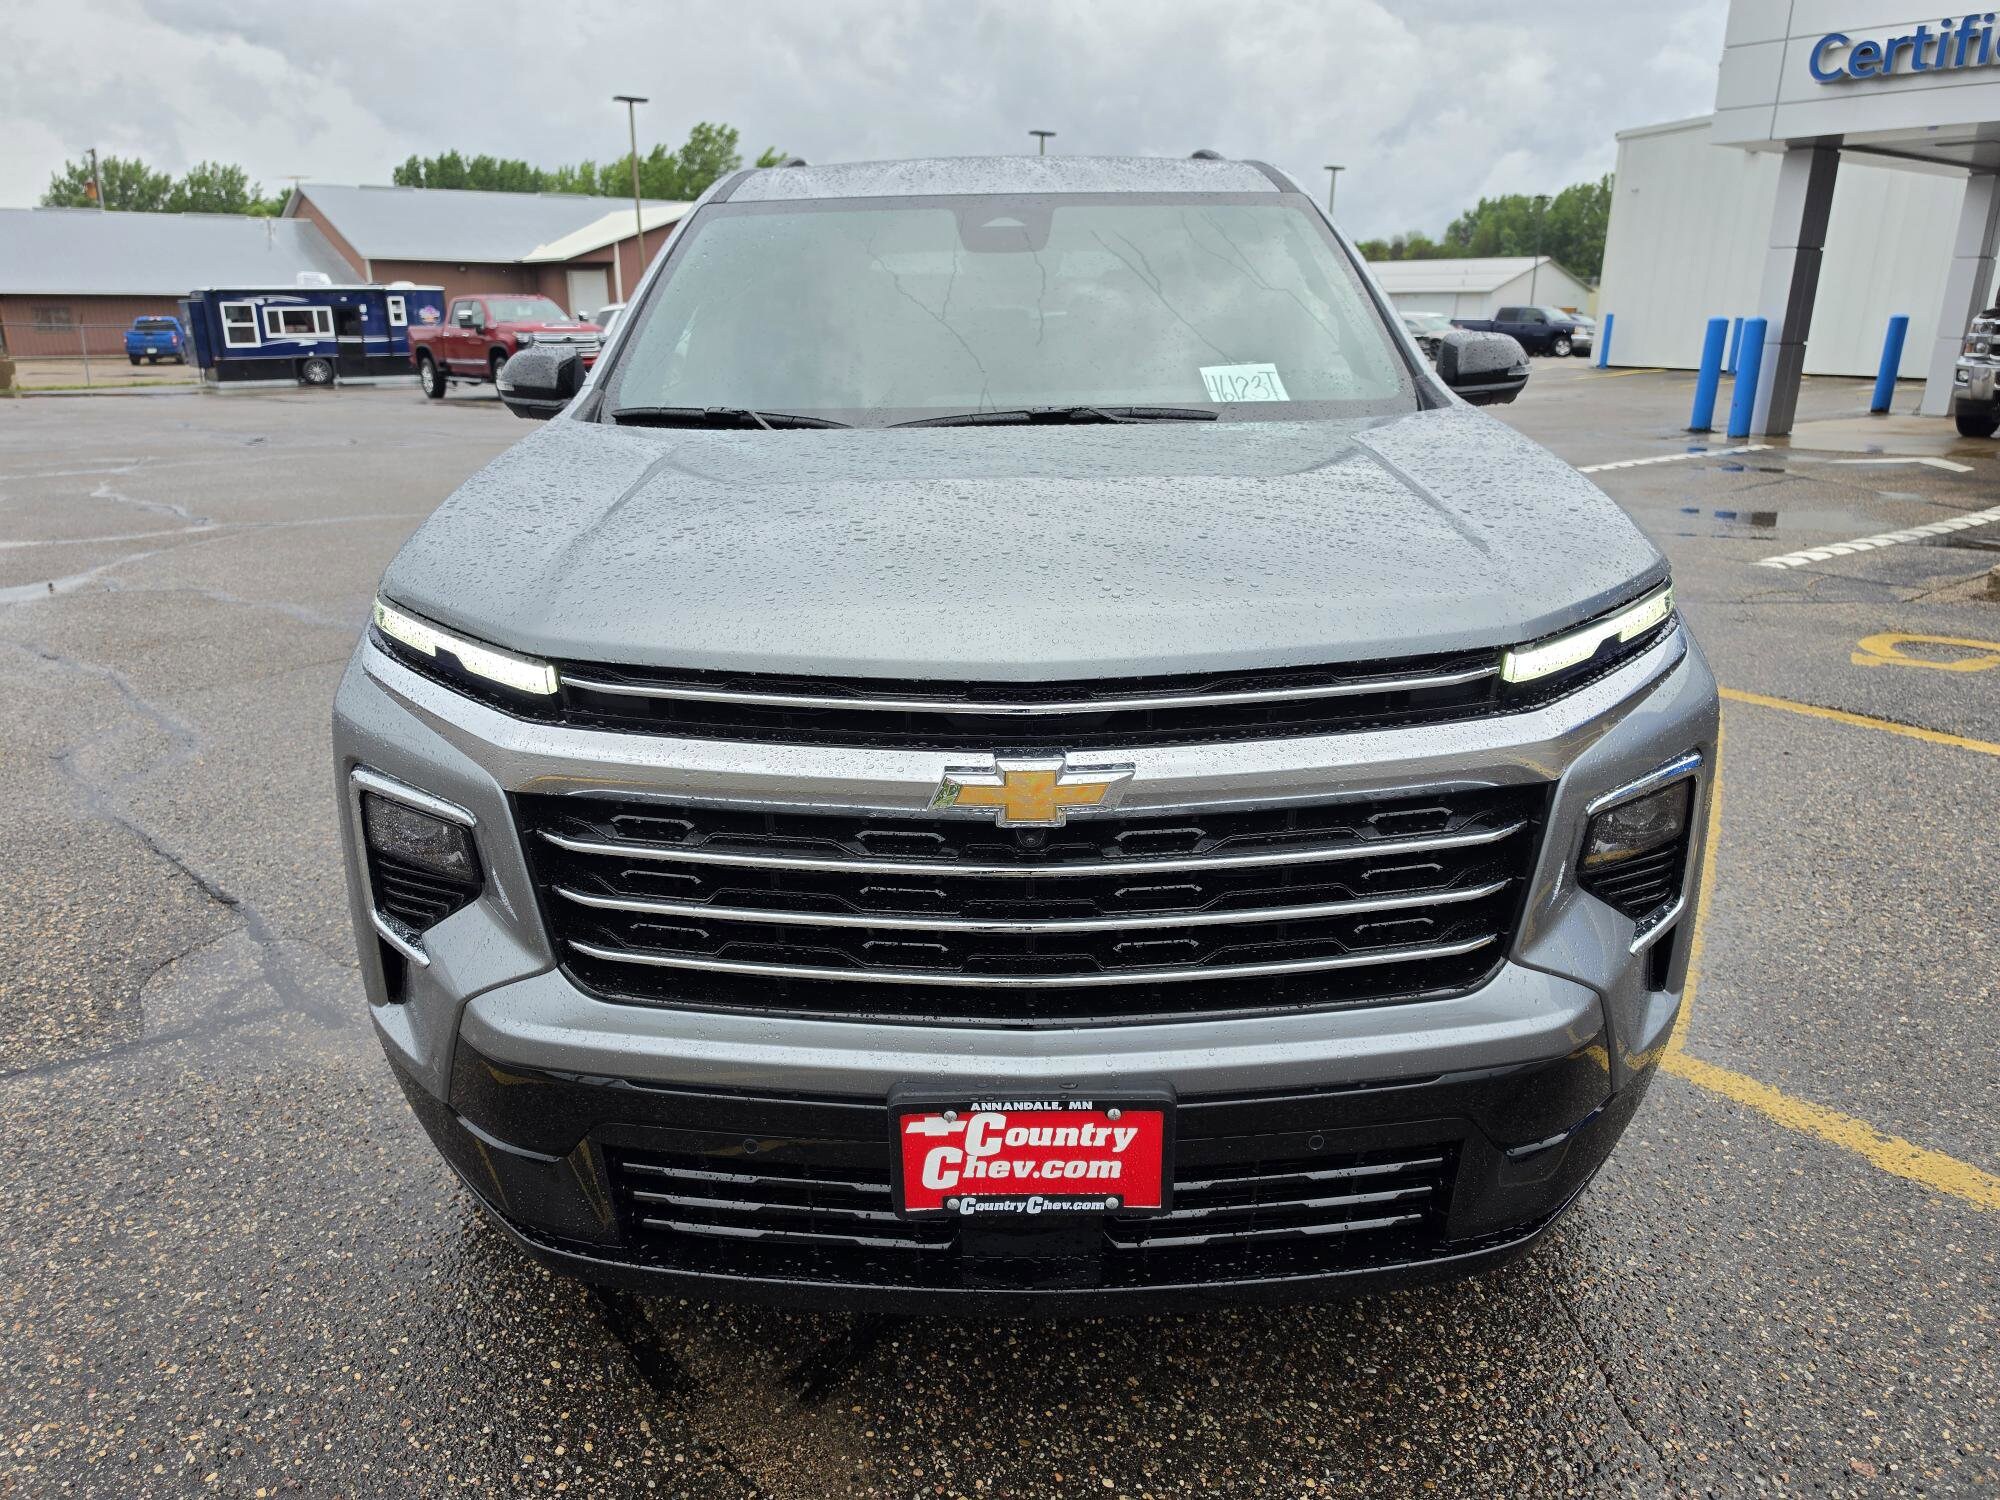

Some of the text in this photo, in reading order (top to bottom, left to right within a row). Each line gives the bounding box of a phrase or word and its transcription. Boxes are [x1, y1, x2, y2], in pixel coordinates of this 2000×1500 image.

[1808, 12, 2000, 83] Certifi
[970, 1101, 1093, 1111] ANNANDALE, MN
[964, 1112, 1139, 1157] Country
[922, 1146, 1122, 1190] Chev.com
[959, 1196, 1105, 1215] CountryChev.com
